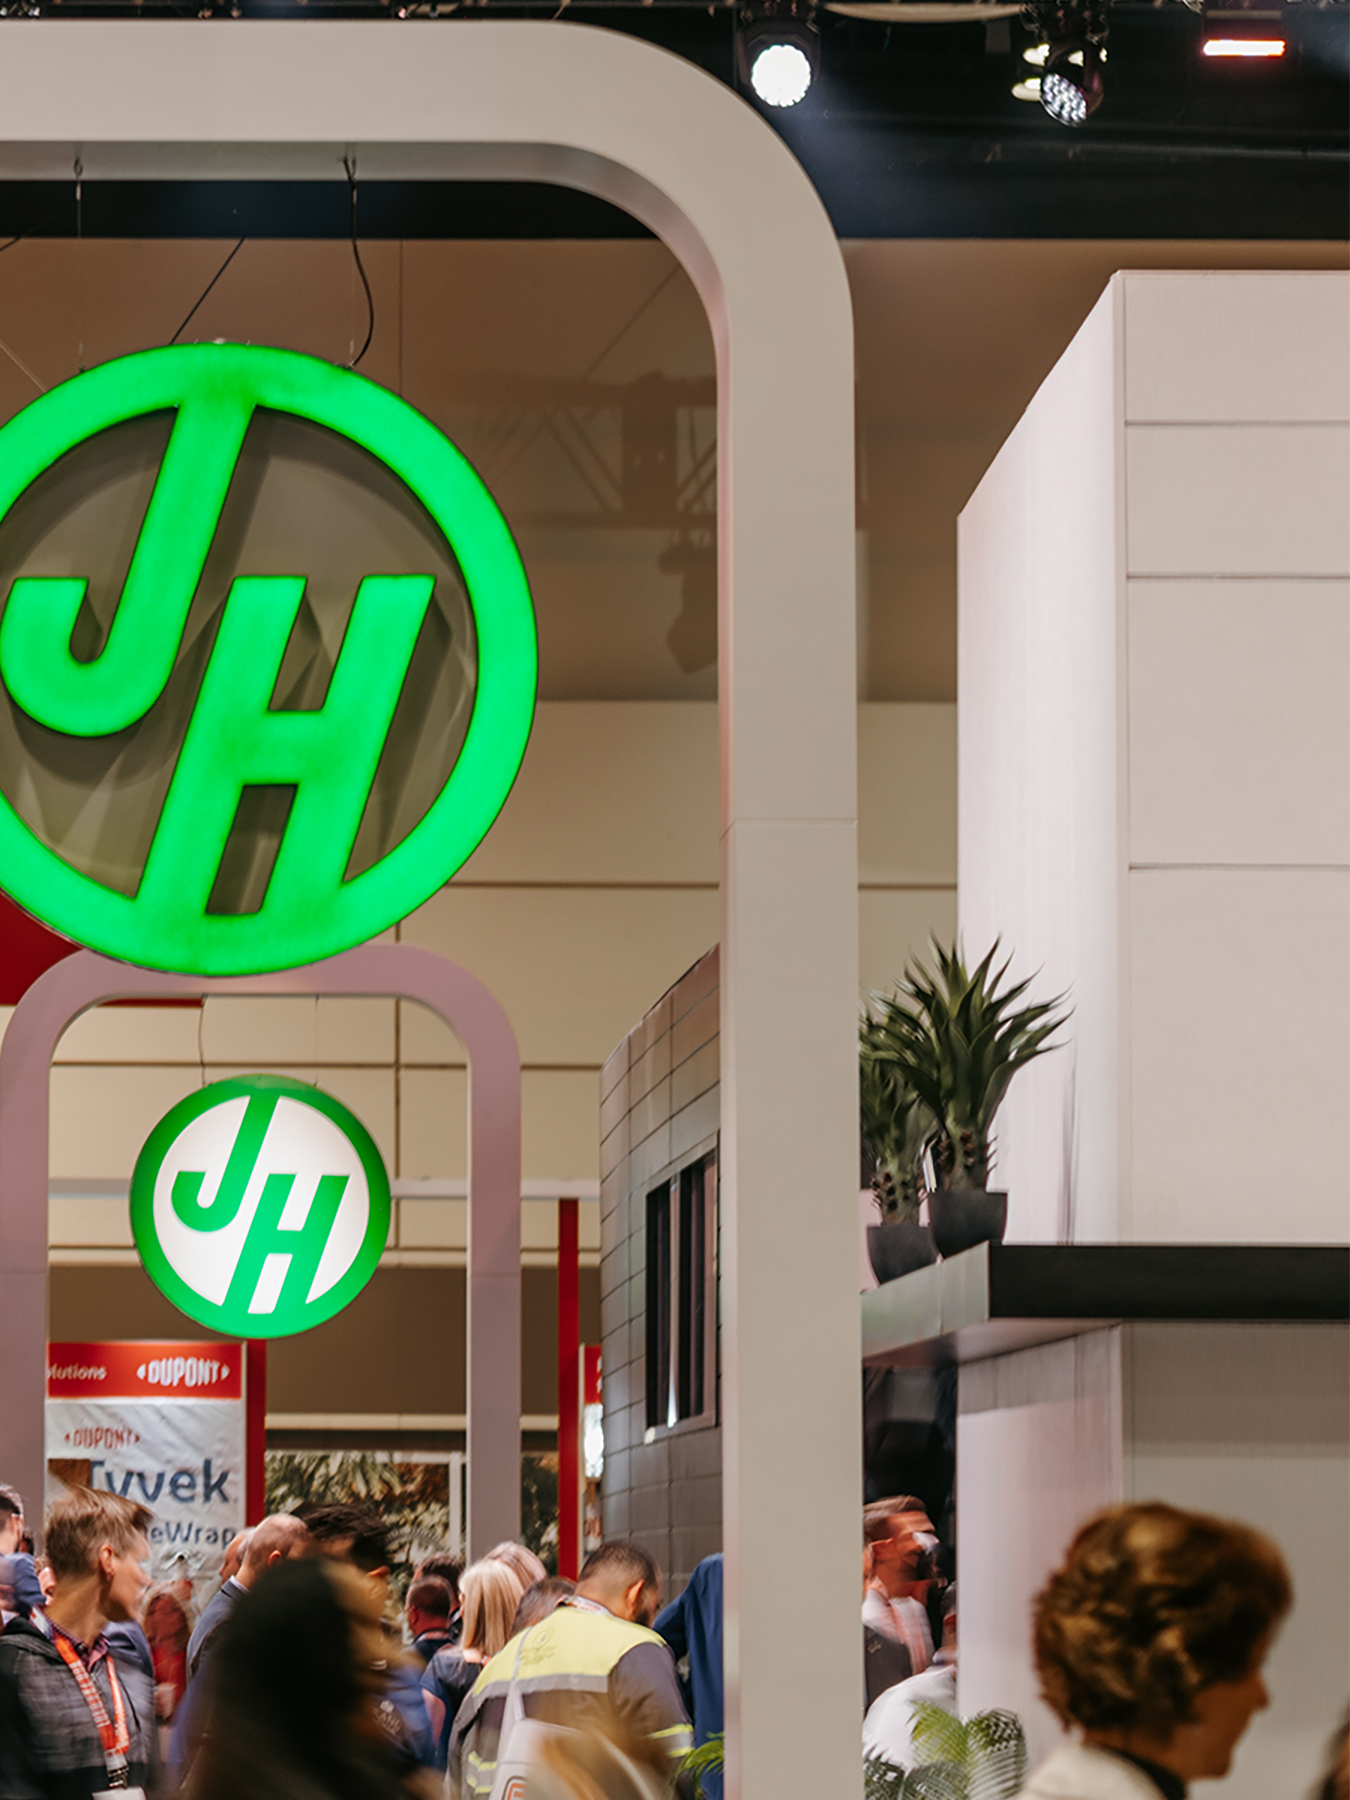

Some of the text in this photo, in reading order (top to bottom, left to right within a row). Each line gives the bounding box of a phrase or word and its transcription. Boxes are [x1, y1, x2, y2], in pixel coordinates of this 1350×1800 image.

[0, 385, 436, 935] JH
[171, 1088, 350, 1322] JH
[148, 1356, 221, 1387] DUPONT
[72, 1426, 133, 1450] DUPONT
[149, 1521, 237, 1550] eWrap
